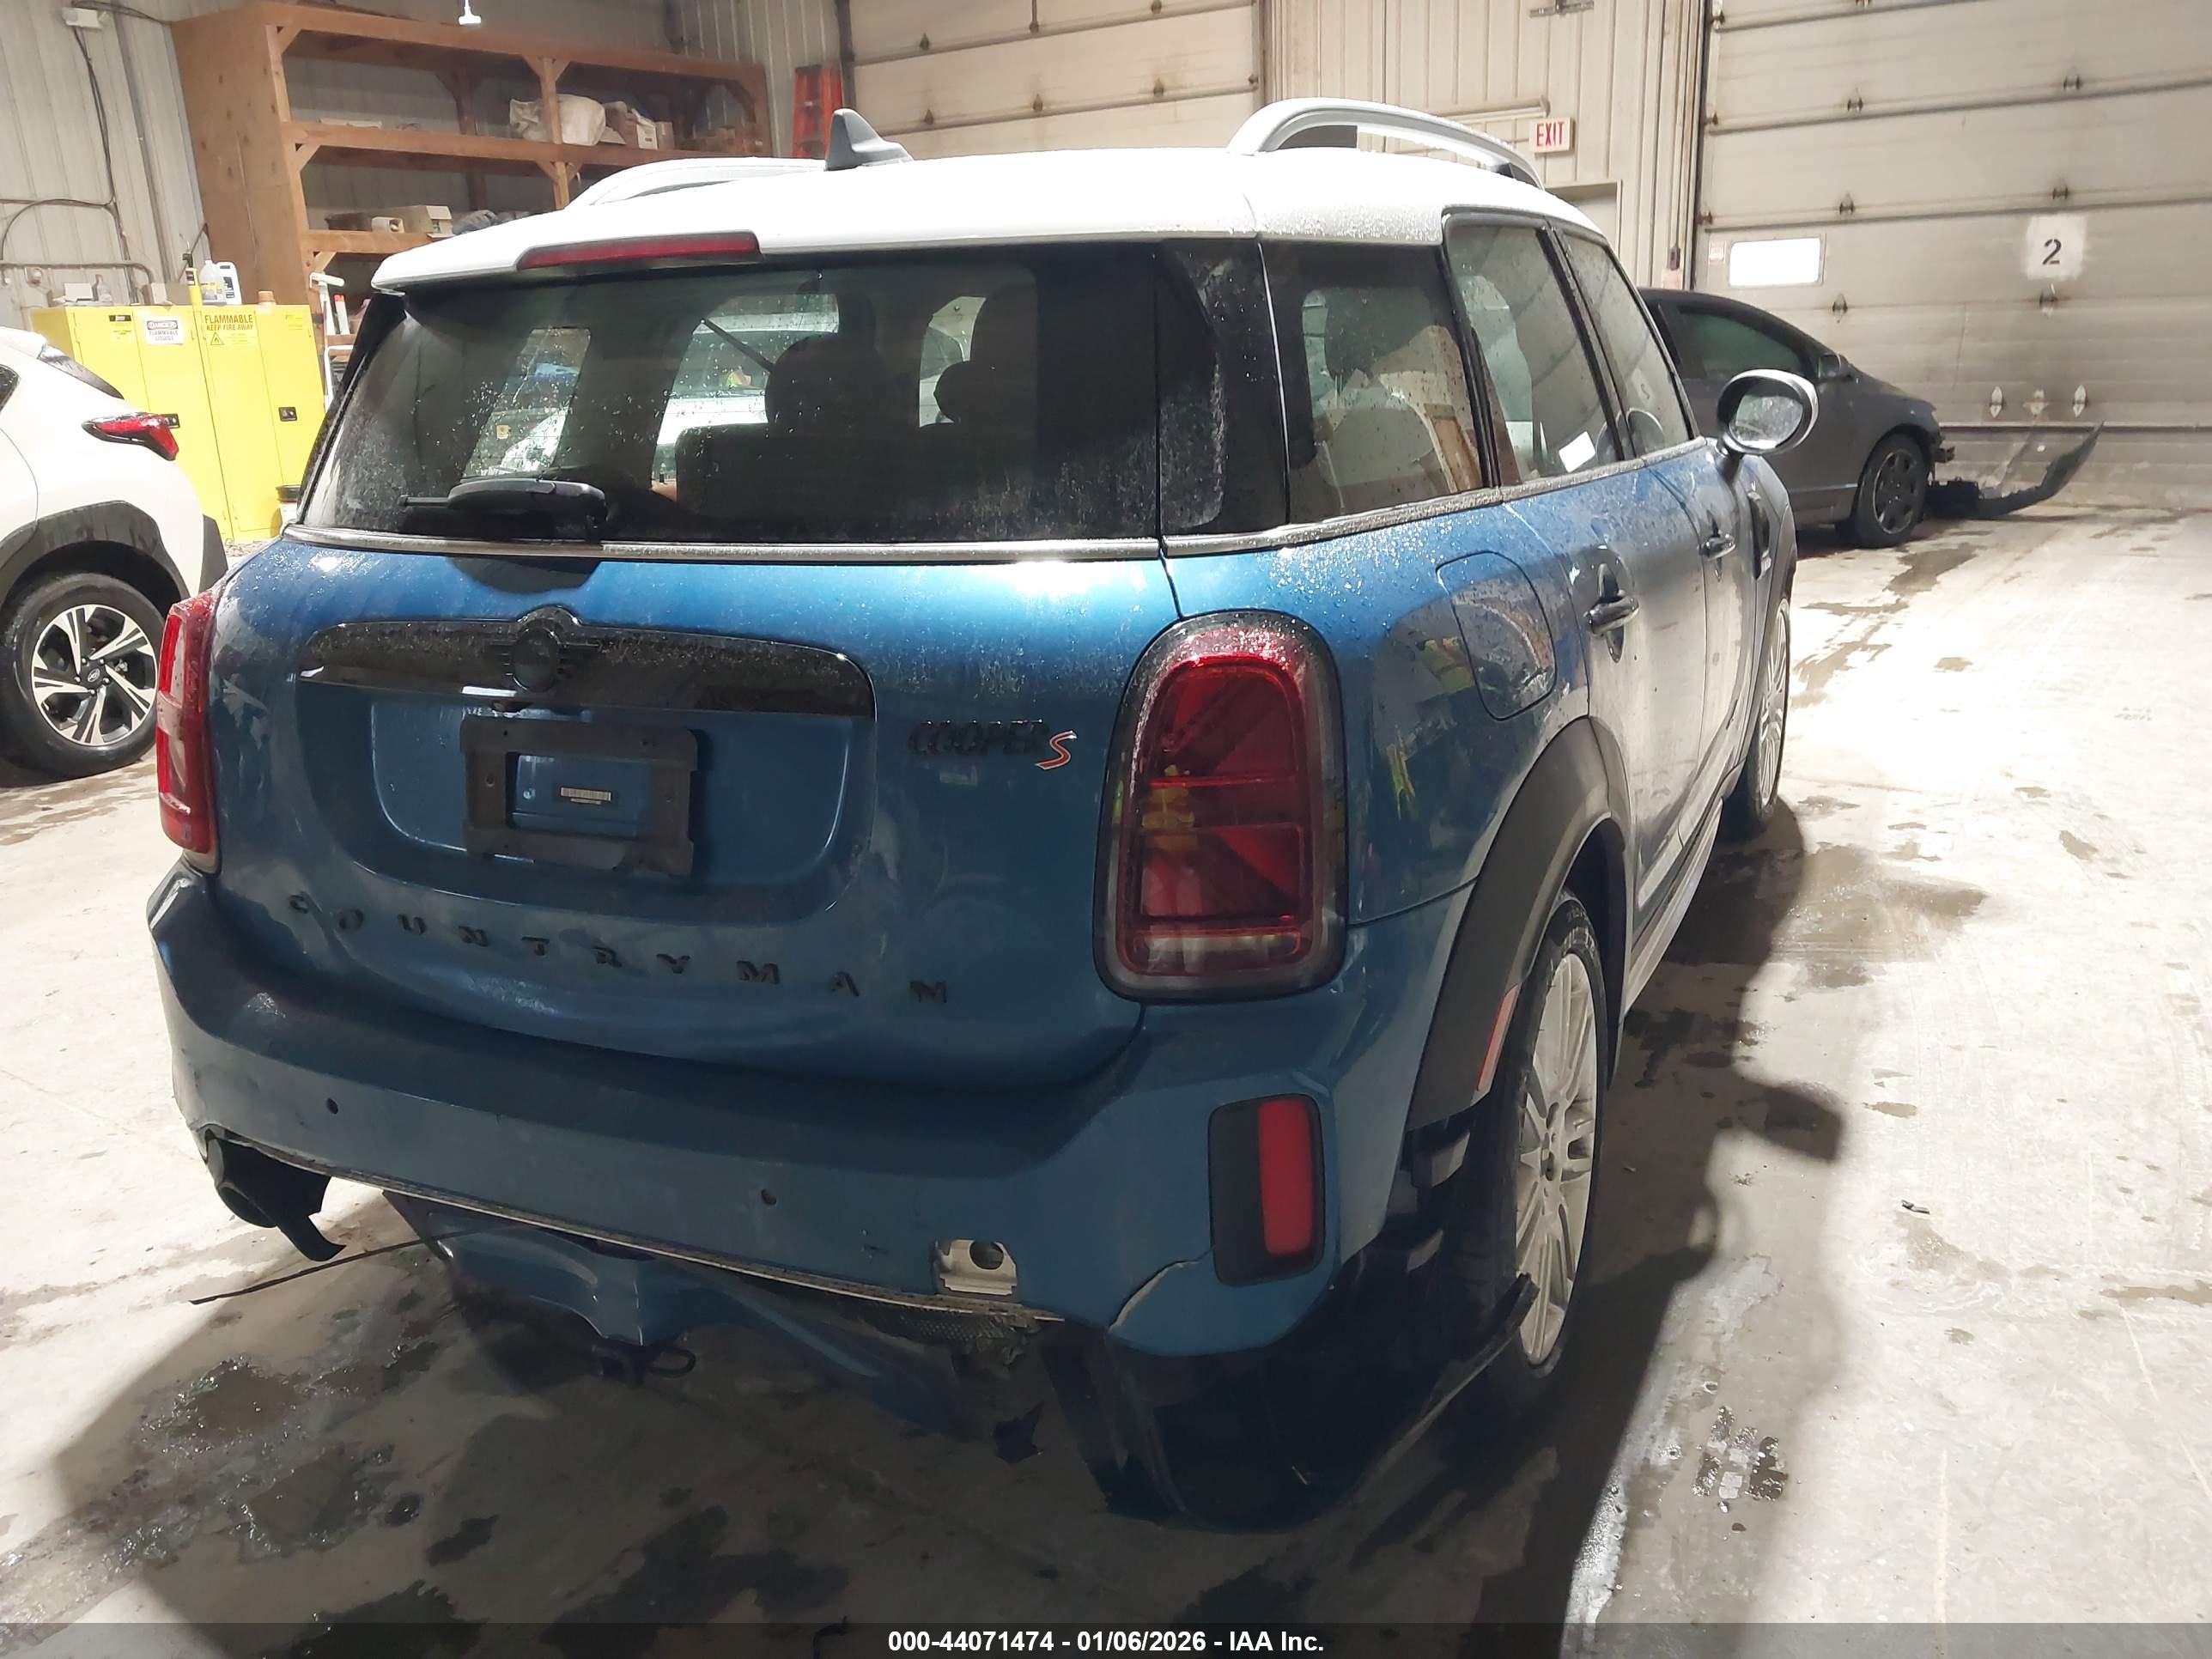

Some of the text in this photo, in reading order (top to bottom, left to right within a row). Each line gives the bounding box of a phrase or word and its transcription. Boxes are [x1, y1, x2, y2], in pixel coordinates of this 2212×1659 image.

[1535, 121, 1565, 147] EXIT
[2042, 238, 2062, 265] 2
[204, 313, 253, 324] FLAMMABLE
[907, 719, 1078, 770] COOPER S
[289, 893, 948, 1005] COUNTRYMAN
